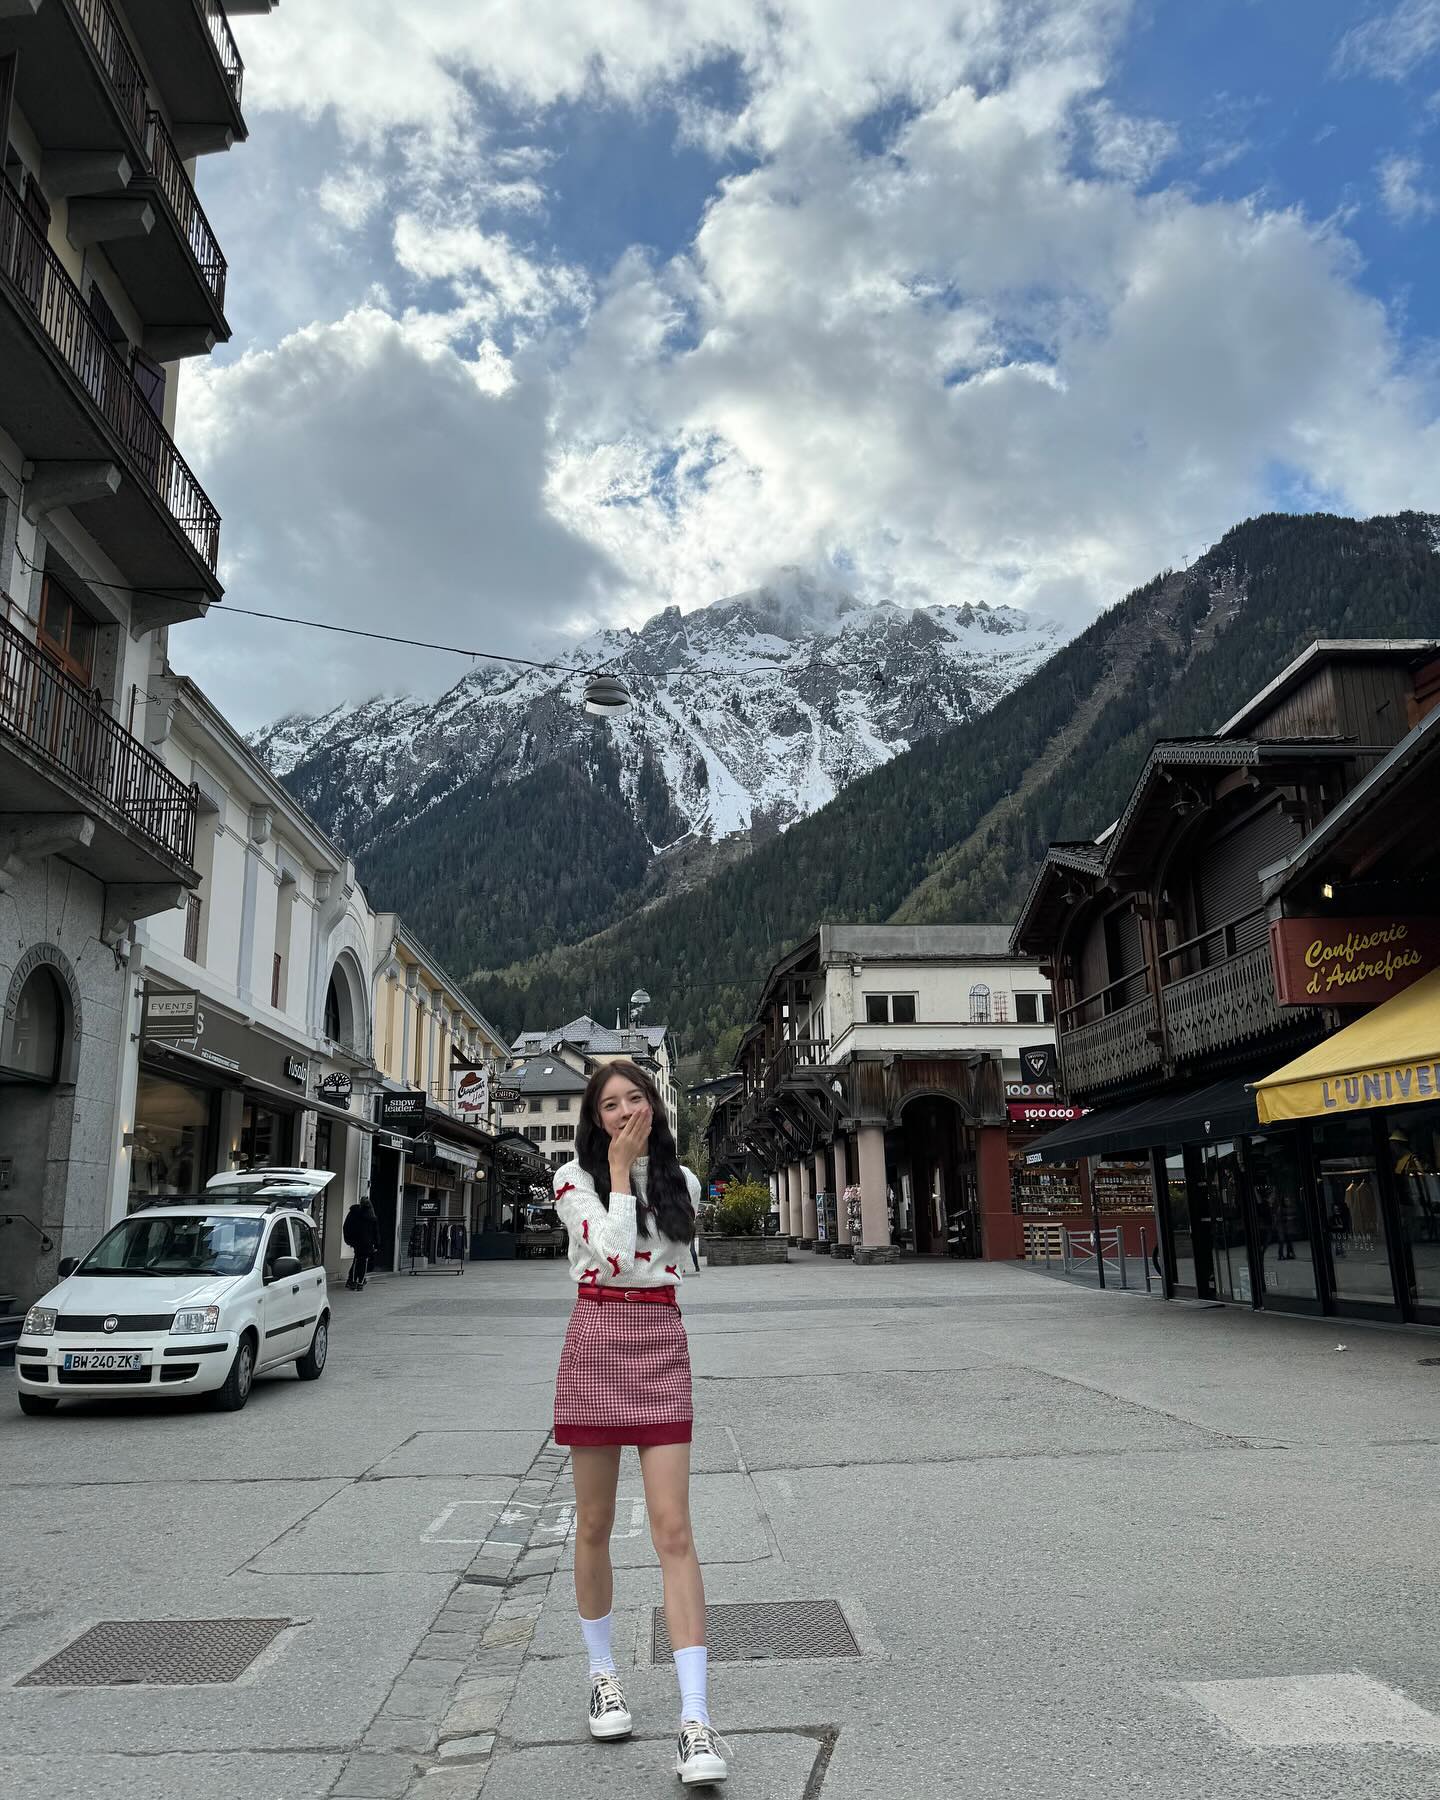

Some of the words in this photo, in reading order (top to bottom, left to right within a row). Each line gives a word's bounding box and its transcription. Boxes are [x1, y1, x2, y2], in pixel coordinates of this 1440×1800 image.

[1304, 923, 1408, 968] Confiserie
[1306, 950, 1422, 994] d'Autrefois
[151, 1002, 193, 1010] EVENTS
[1006, 1084, 1031, 1096] 100
[390, 1099, 416, 1107] snow
[1024, 1109, 1047, 1118] 100
[1048, 1109, 1074, 1118] 000
[73, 1355, 132, 1368] BW-240-ZK
